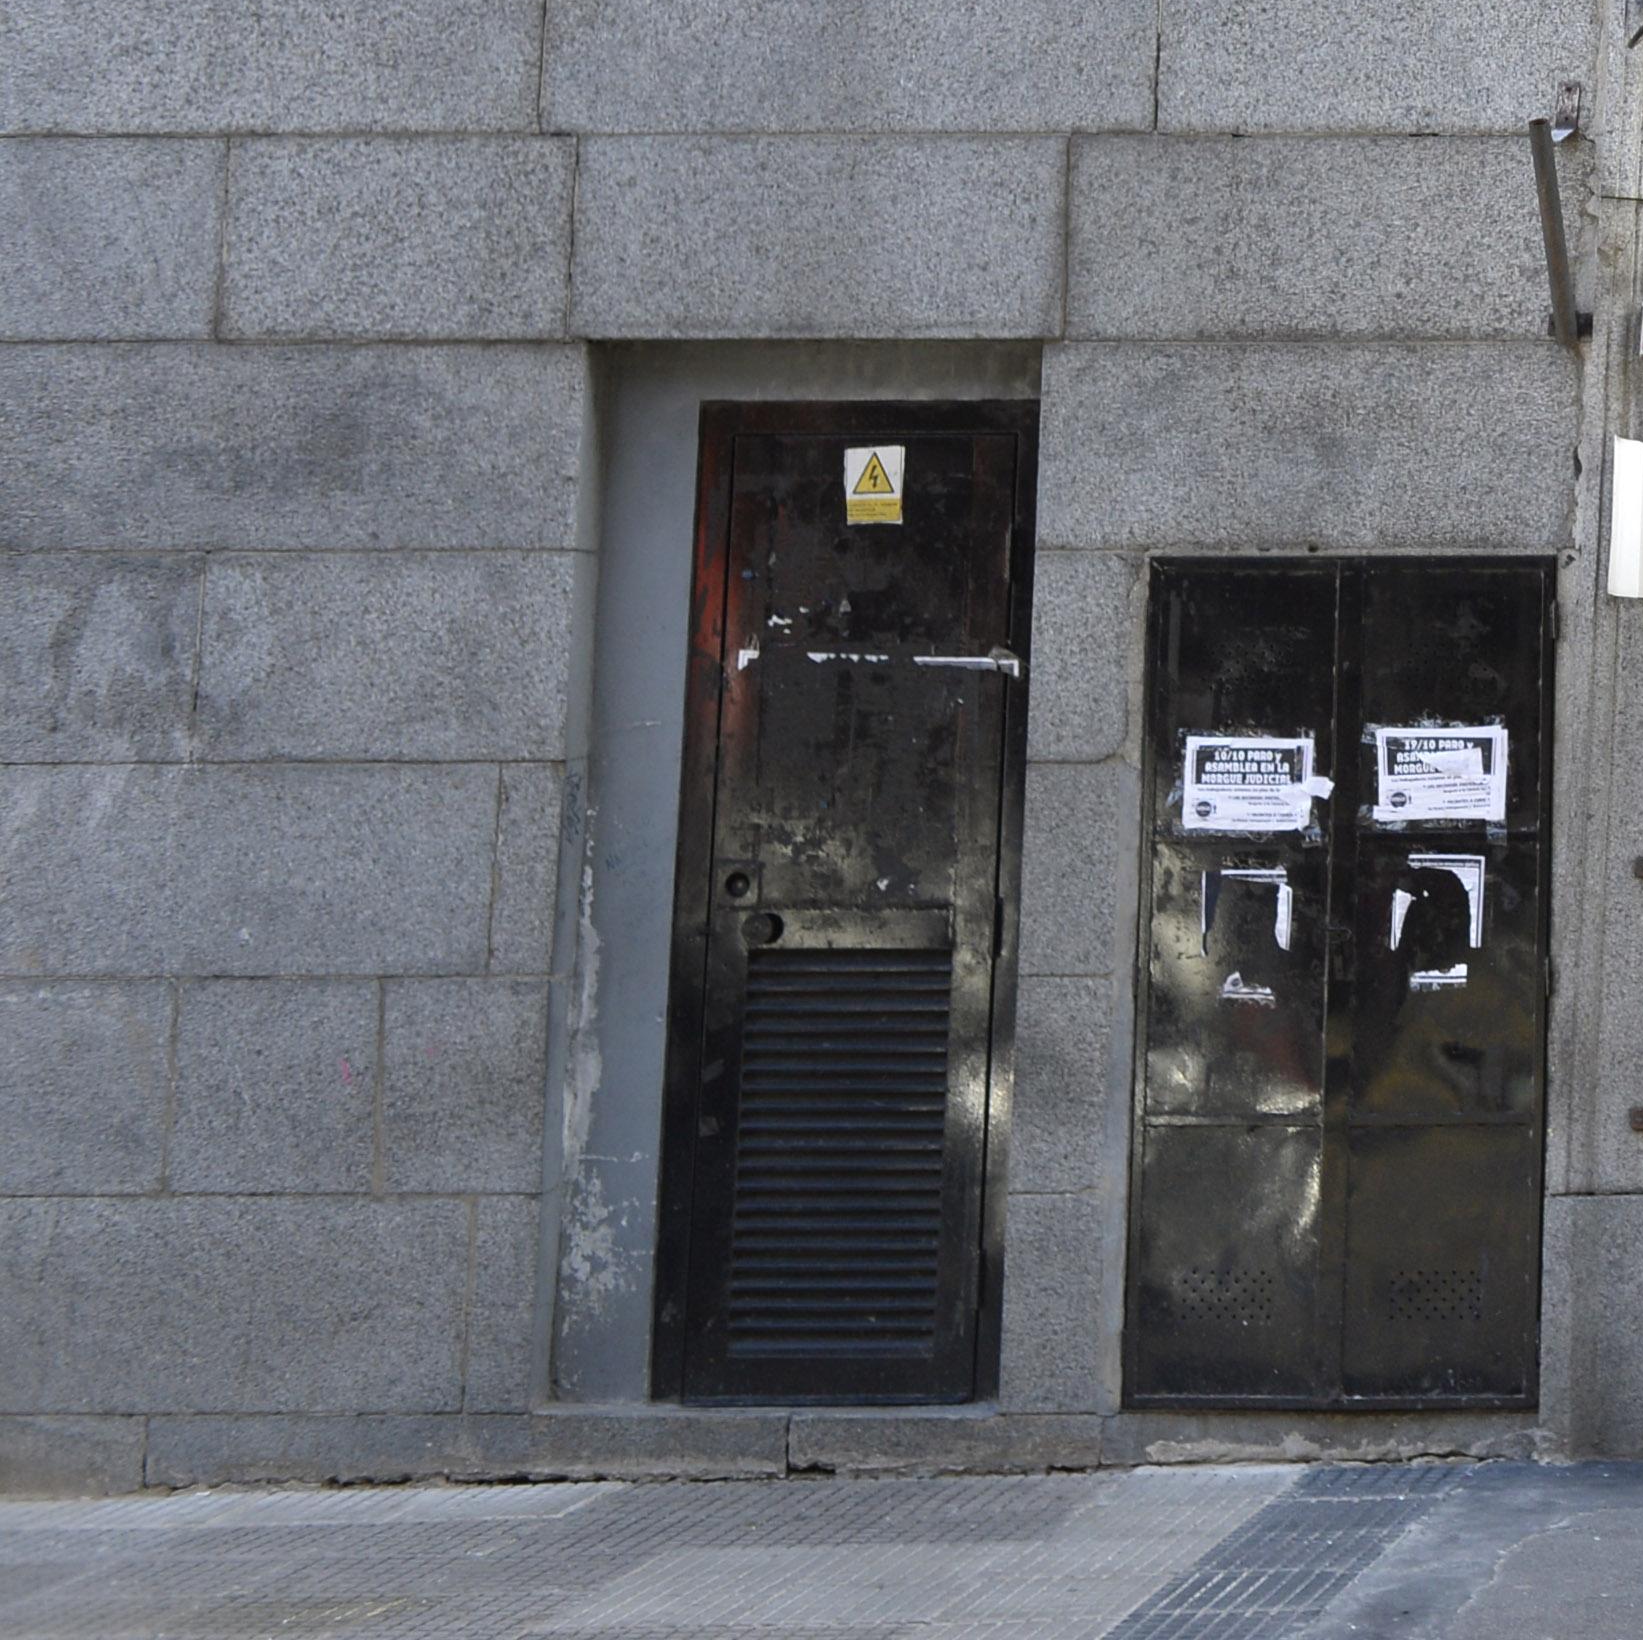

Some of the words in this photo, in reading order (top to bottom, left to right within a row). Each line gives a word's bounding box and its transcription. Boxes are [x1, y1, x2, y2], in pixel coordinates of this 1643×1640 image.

[1405, 739, 1436, 750] 19/10
[1439, 739, 1465, 750] PARO
[1248, 750, 1273, 761] PARO
[1205, 762, 1258, 772] ASAMBLEA
[1260, 762, 1275, 772] EN
[1277, 762, 1289, 773] LA
[1202, 773, 1243, 784] MORGUE
[1245, 773, 1292, 784] JUDICIAL
